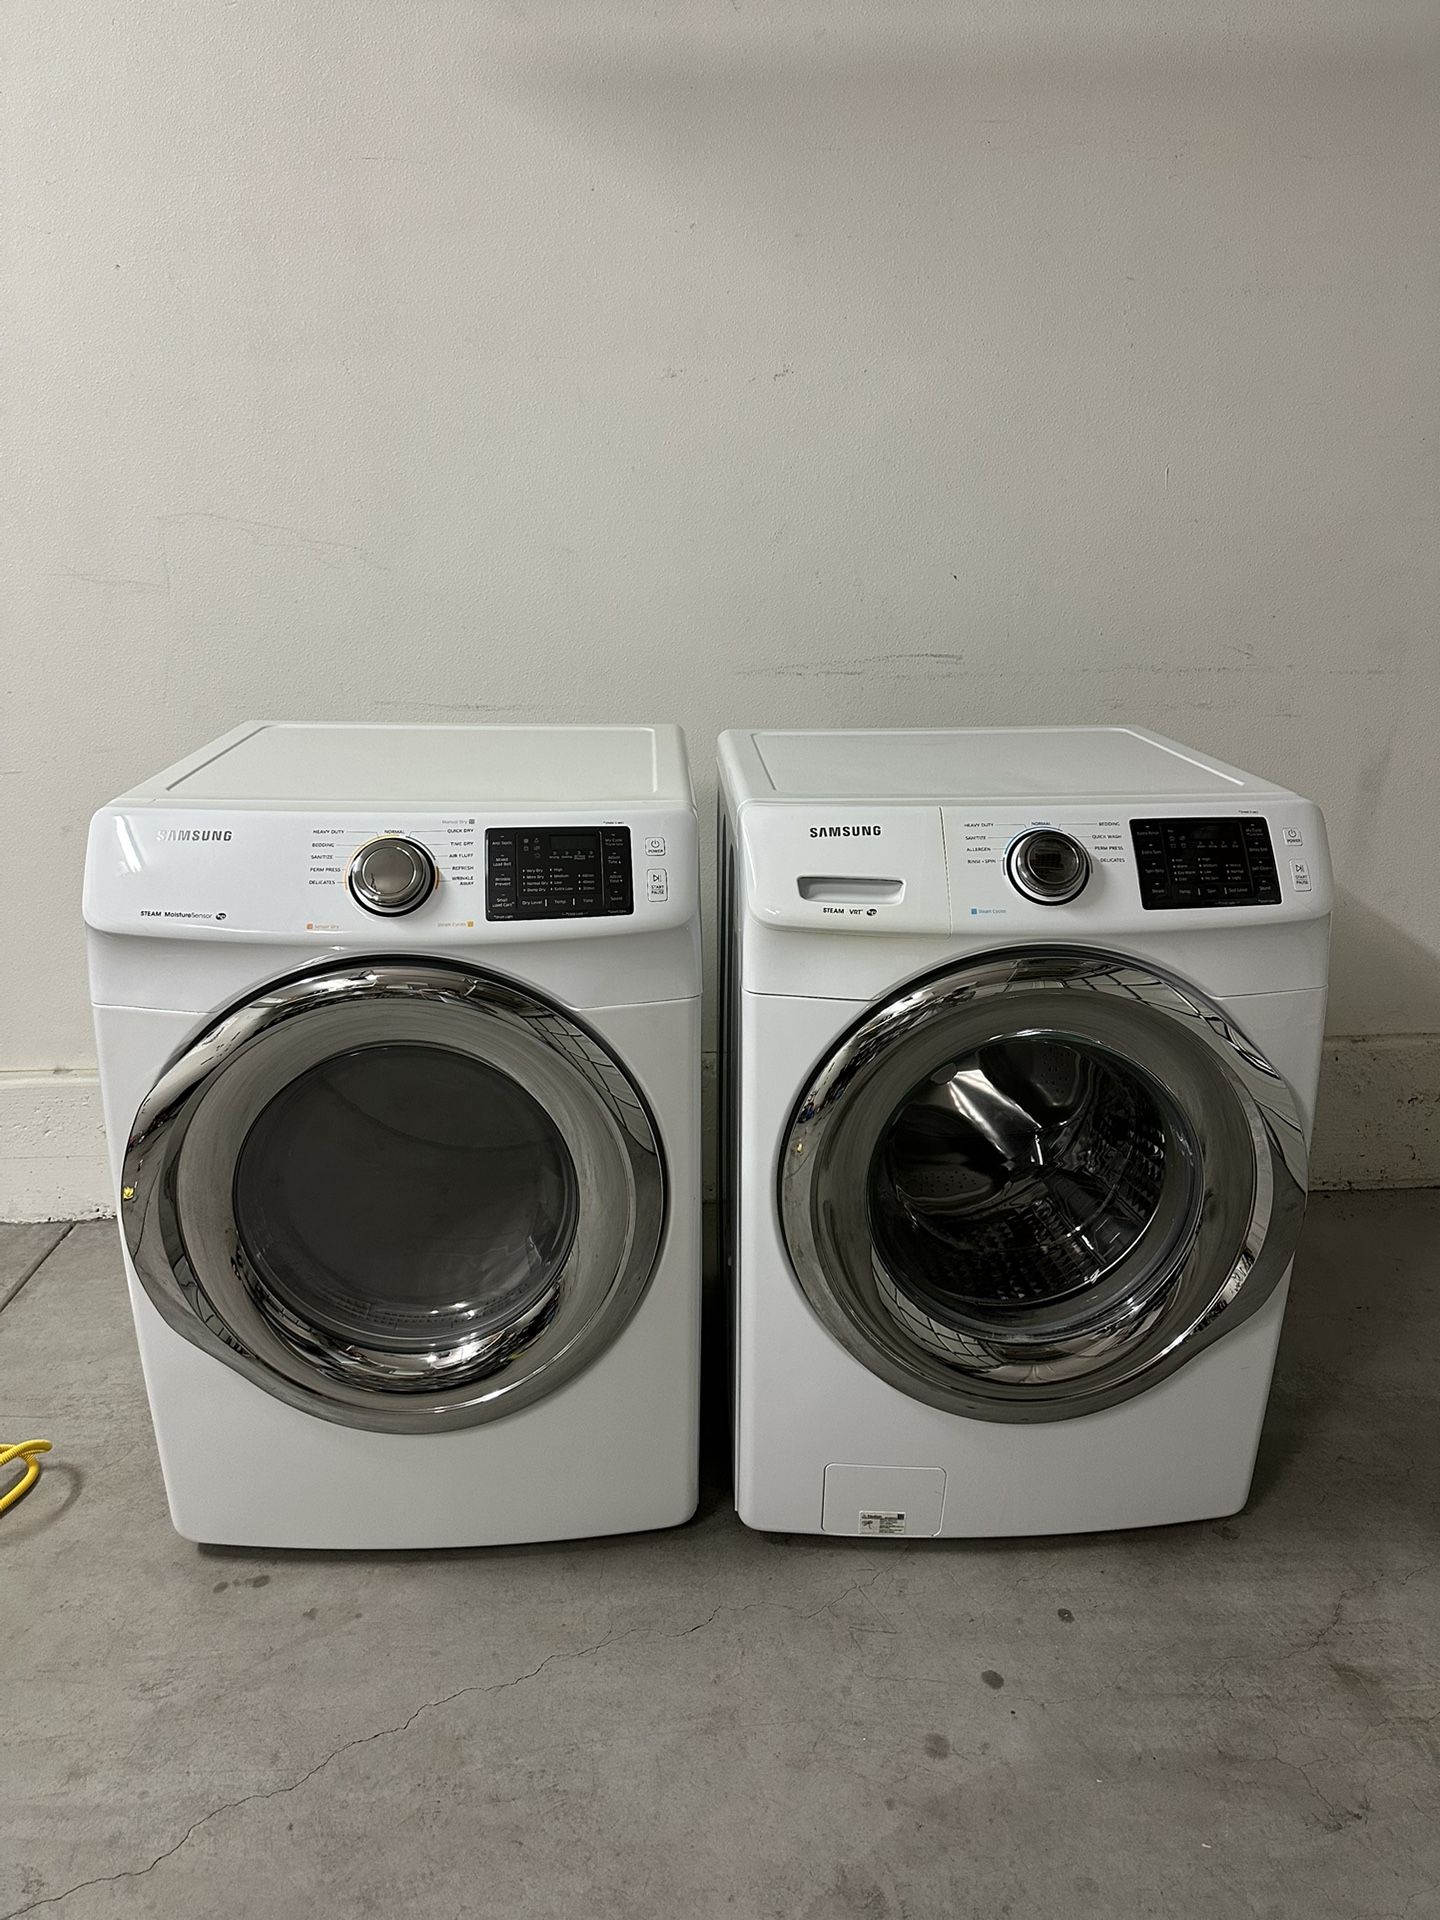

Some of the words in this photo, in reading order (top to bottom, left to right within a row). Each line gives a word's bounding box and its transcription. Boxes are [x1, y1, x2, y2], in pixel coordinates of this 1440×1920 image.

[156, 830, 233, 842] SAMSUNG
[810, 825, 882, 838] SAMSUNG
[164, 911, 212, 920] MoistureSensor
